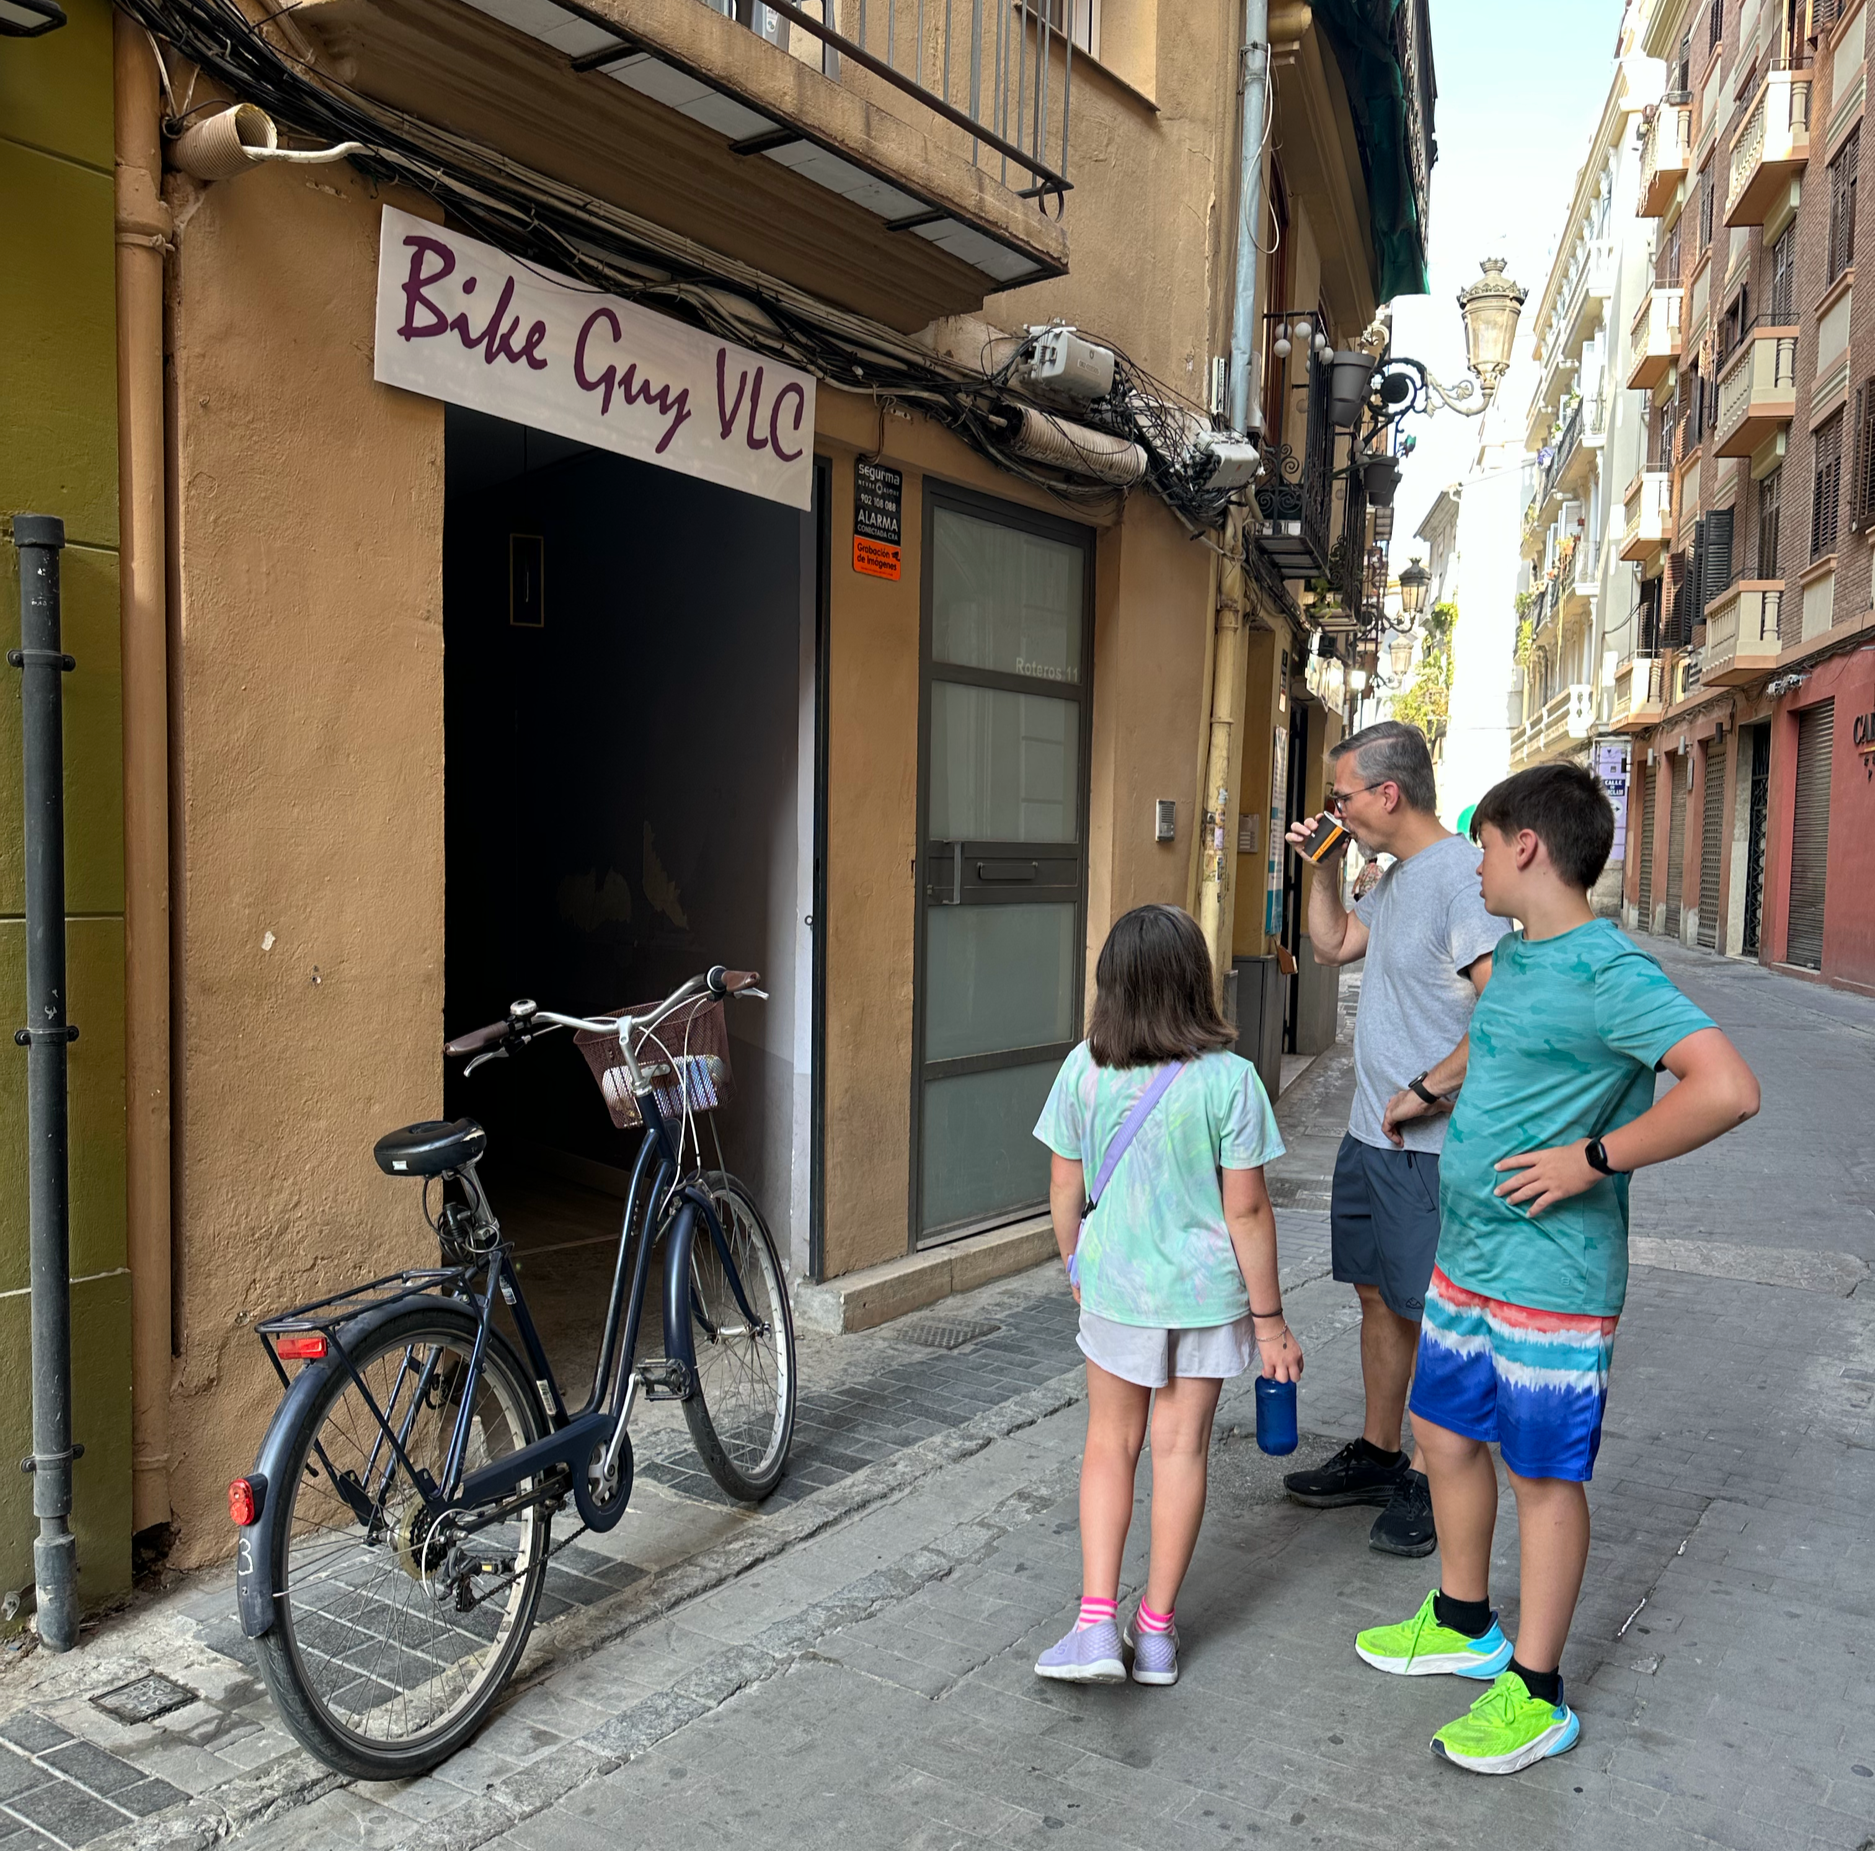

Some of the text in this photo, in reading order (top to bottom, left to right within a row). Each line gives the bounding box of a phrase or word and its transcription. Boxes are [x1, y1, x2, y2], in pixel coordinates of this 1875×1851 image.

[397, 235, 805, 462] Bike Guy VLC
[858, 463, 900, 486] segurma
[860, 493, 872, 505] 902
[857, 523, 887, 539] CONECTADA
[858, 509, 898, 532] ALARMA
[857, 542, 891, 559] Grabación
[857, 553, 865, 563] de
[1016, 657, 1062, 680] Roteros
[1853, 712, 1875, 746] CA
[238, 1538, 254, 1576] 3
